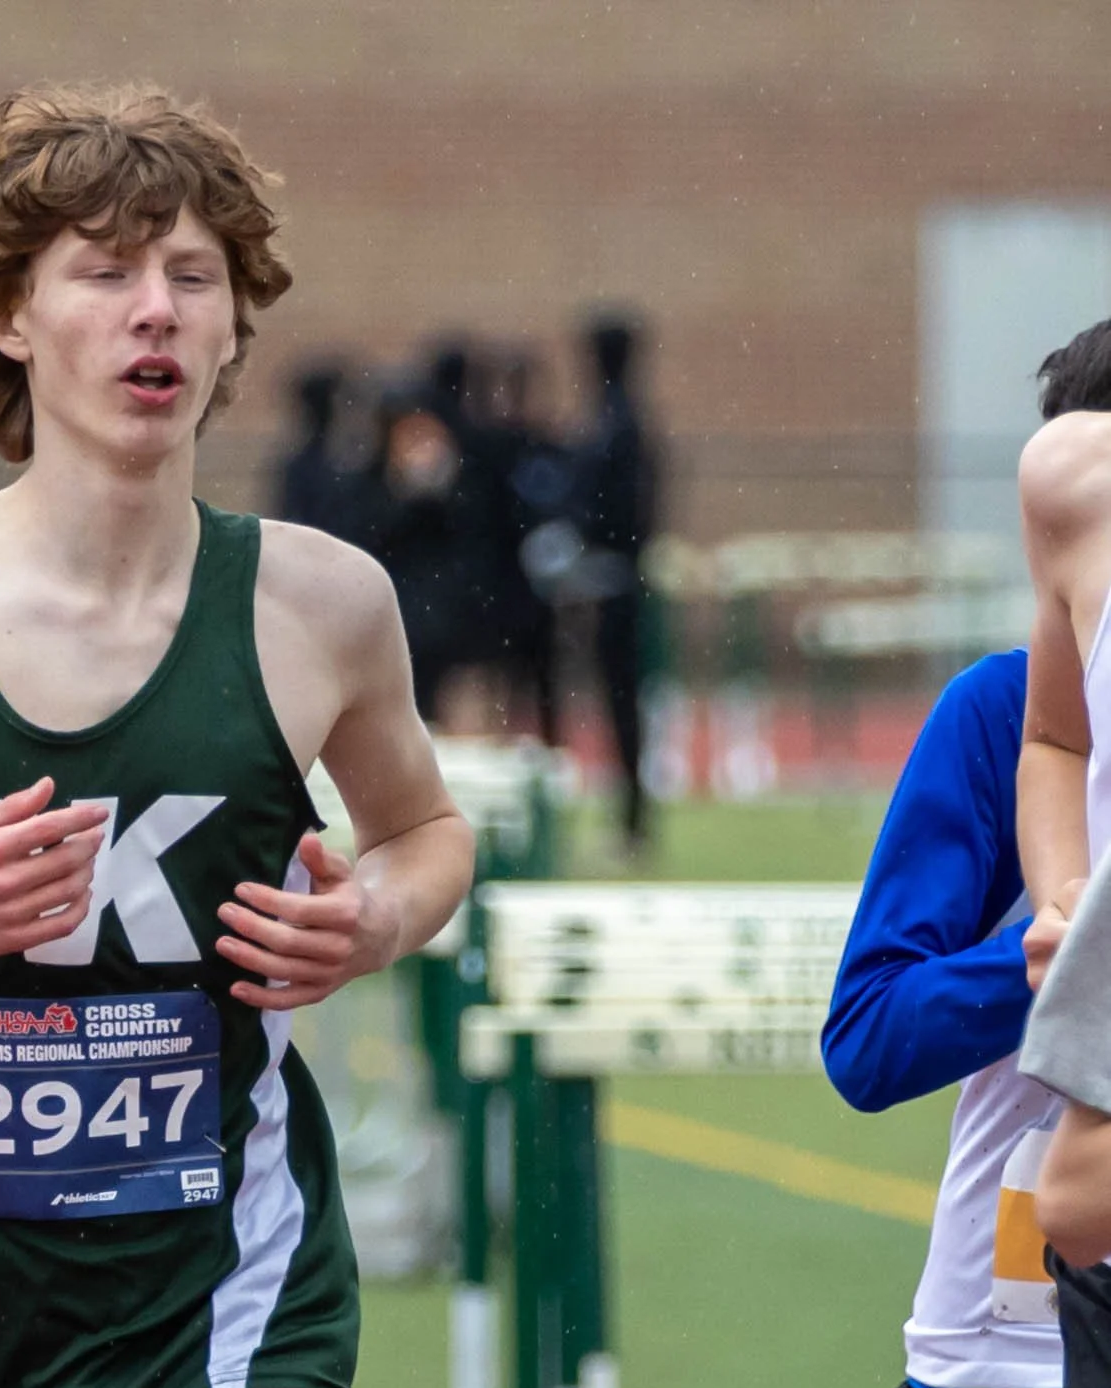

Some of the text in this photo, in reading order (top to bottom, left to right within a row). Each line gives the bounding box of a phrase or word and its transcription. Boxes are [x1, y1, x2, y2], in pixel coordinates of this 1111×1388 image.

[85, 1003, 156, 1021] CROSS
[85, 1018, 182, 1038] COUNTRY
[16, 1043, 85, 1062] REGIONAL
[89, 1037, 193, 1060] CHAMPIONSHIP
[183, 1188, 220, 1204] 2947
